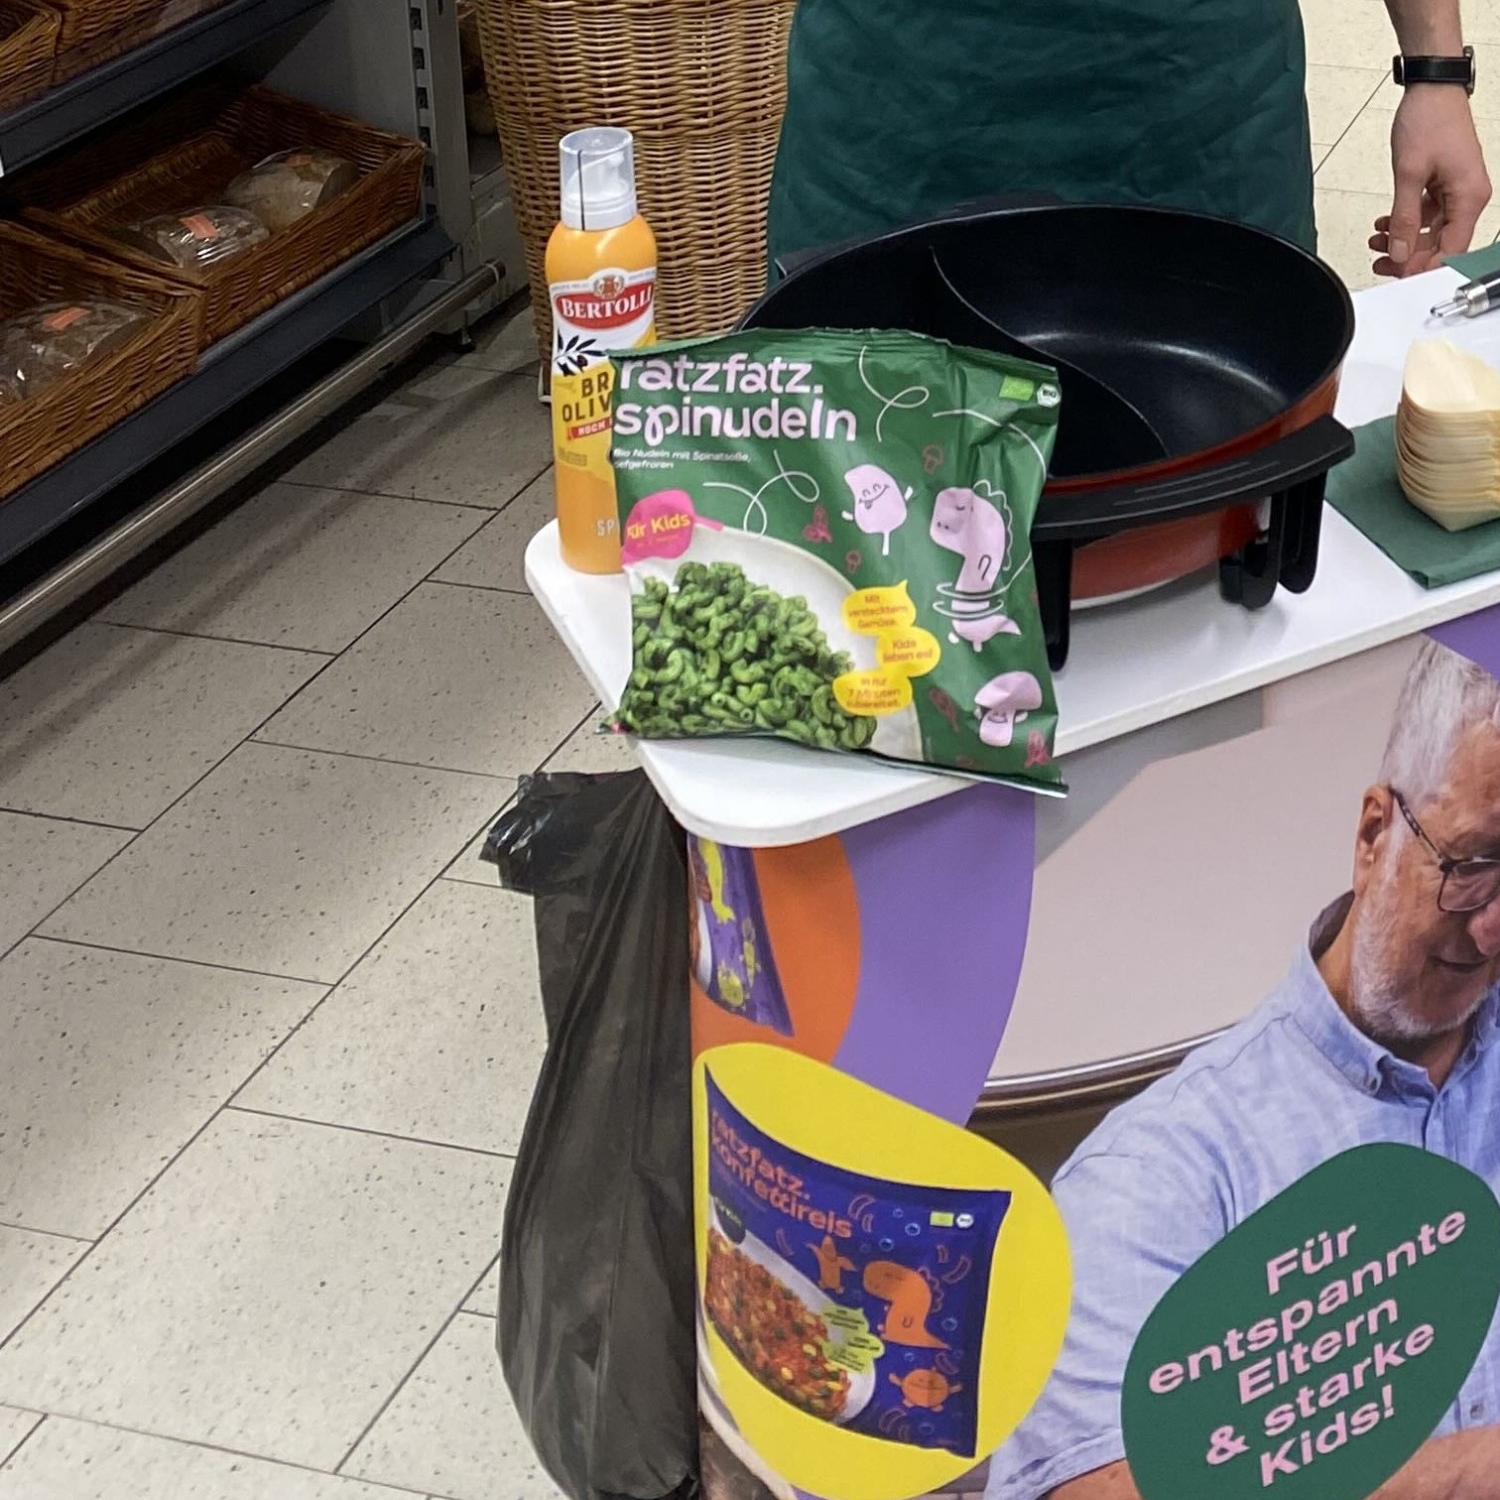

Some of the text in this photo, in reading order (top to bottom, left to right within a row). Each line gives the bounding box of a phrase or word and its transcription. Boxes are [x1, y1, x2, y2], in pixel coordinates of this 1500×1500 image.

[560, 286, 653, 319] BERTOLLI
[620, 353, 824, 394] ratzfatz.
[613, 395, 857, 447] spinudeln
[632, 447, 670, 459] Nudeln
[672, 450, 690, 461] mit
[651, 513, 692, 535] Kids
[1266, 1224, 1357, 1296] Für
[1148, 1210, 1467, 1395] entspannte
[1237, 1299, 1399, 1405] Eltern
[1205, 1323, 1436, 1467] & starke
[1259, 1383, 1395, 1488] Kids!
